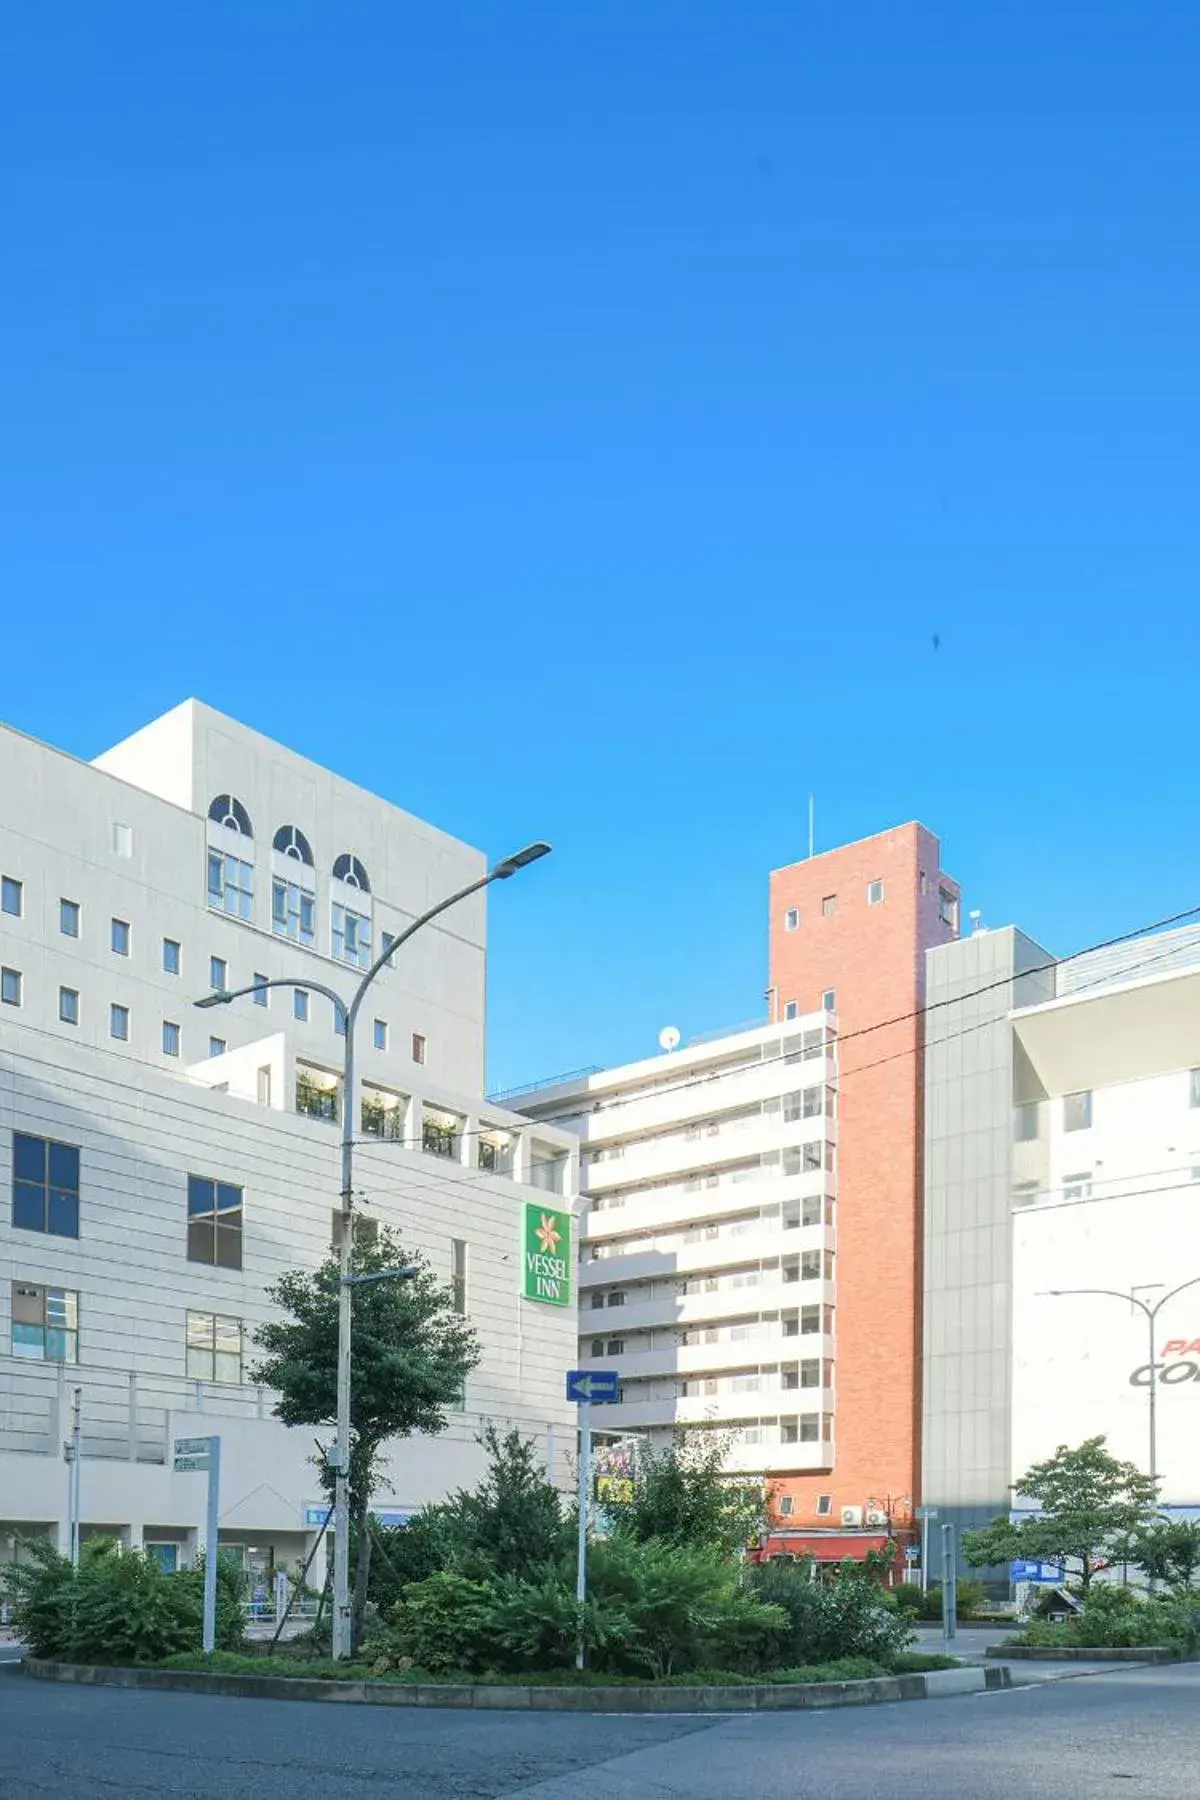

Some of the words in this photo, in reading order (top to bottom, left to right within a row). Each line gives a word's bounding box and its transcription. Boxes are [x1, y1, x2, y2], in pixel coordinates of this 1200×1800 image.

[527, 1251, 569, 1281] VESSEL
[536, 1276, 560, 1299] INN
[1129, 1361, 1200, 1387] CO
